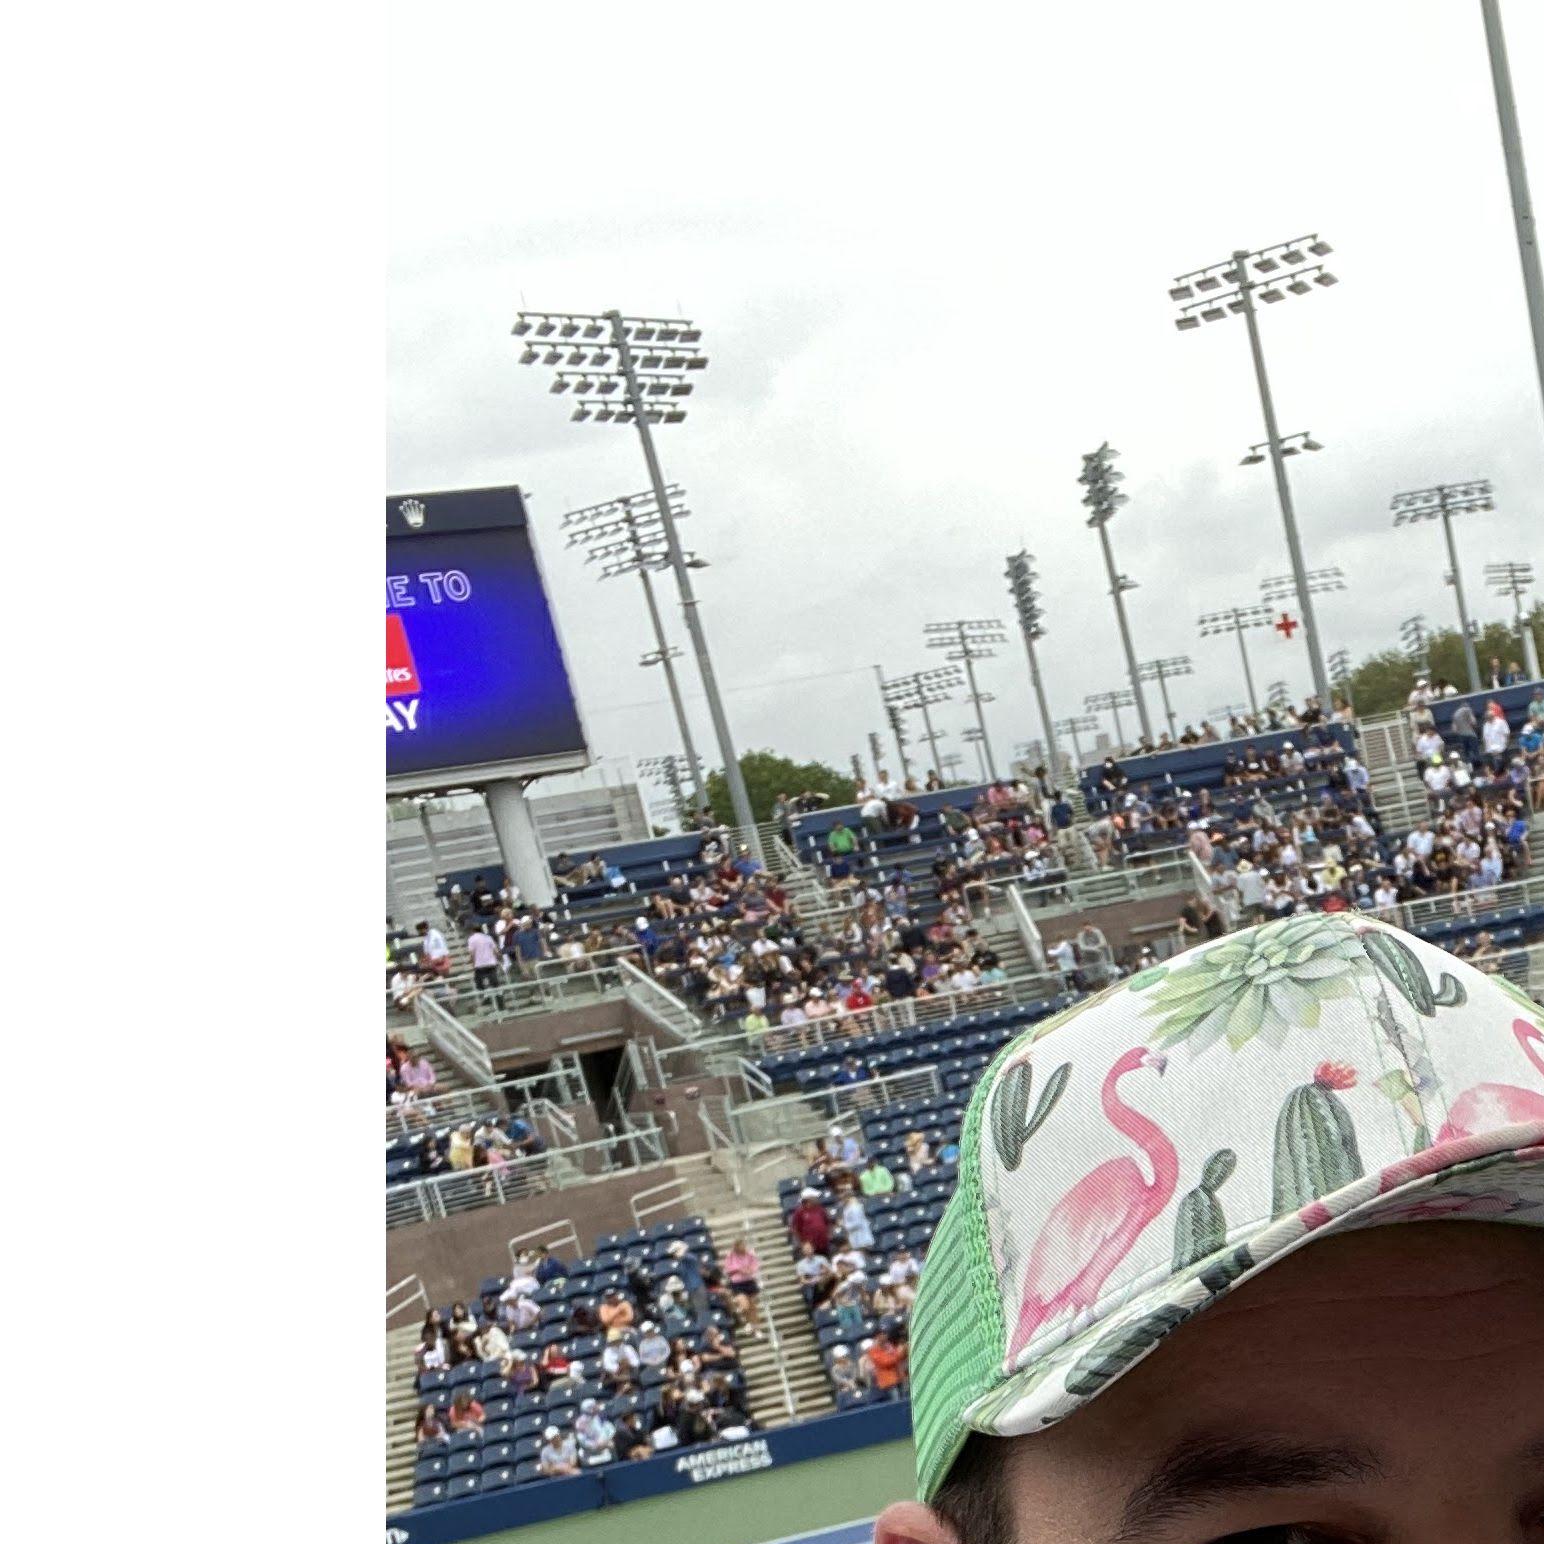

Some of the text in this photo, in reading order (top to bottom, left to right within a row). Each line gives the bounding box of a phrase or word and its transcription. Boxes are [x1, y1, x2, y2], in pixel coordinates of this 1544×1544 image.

[418, 569, 472, 604] TO
[676, 1440, 768, 1472] AMERICAN
[692, 1453, 773, 1482] EXPRESS
